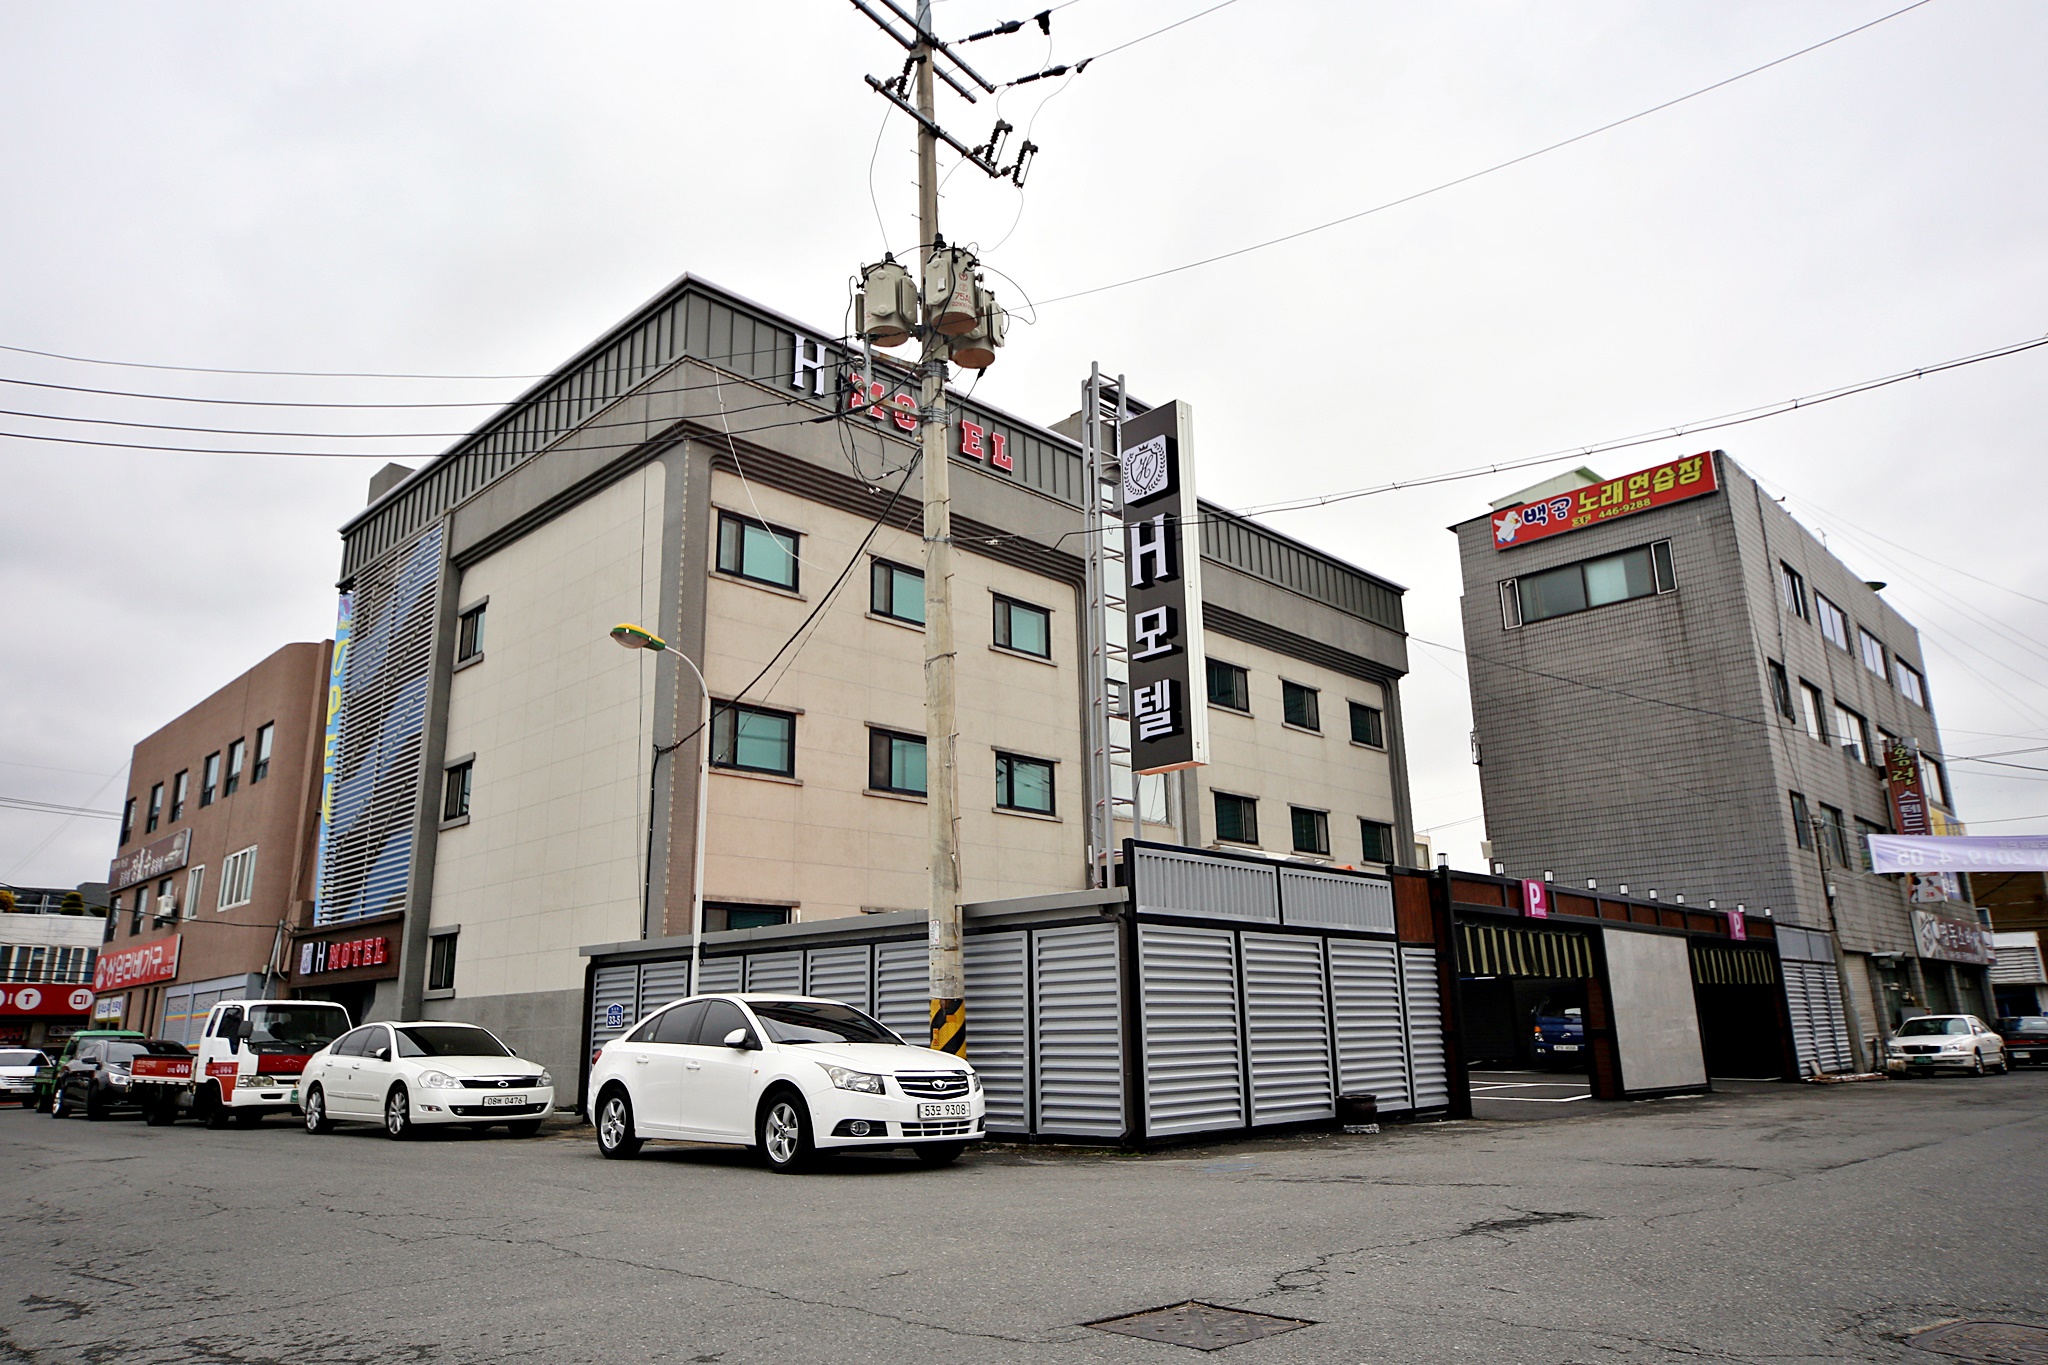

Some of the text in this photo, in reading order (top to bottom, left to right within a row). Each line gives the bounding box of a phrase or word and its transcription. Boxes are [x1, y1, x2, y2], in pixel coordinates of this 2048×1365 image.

[793, 332, 1013, 472] H MOEL
[1577, 456, 1703, 514] 노래연습장
[1598, 497, 1651, 519] 446-9288
[1529, 882, 1541, 915] P
[1733, 913, 1741, 937] P
[315, 937, 386, 973] H MOTEL
[945, 1104, 966, 1116] 9308
